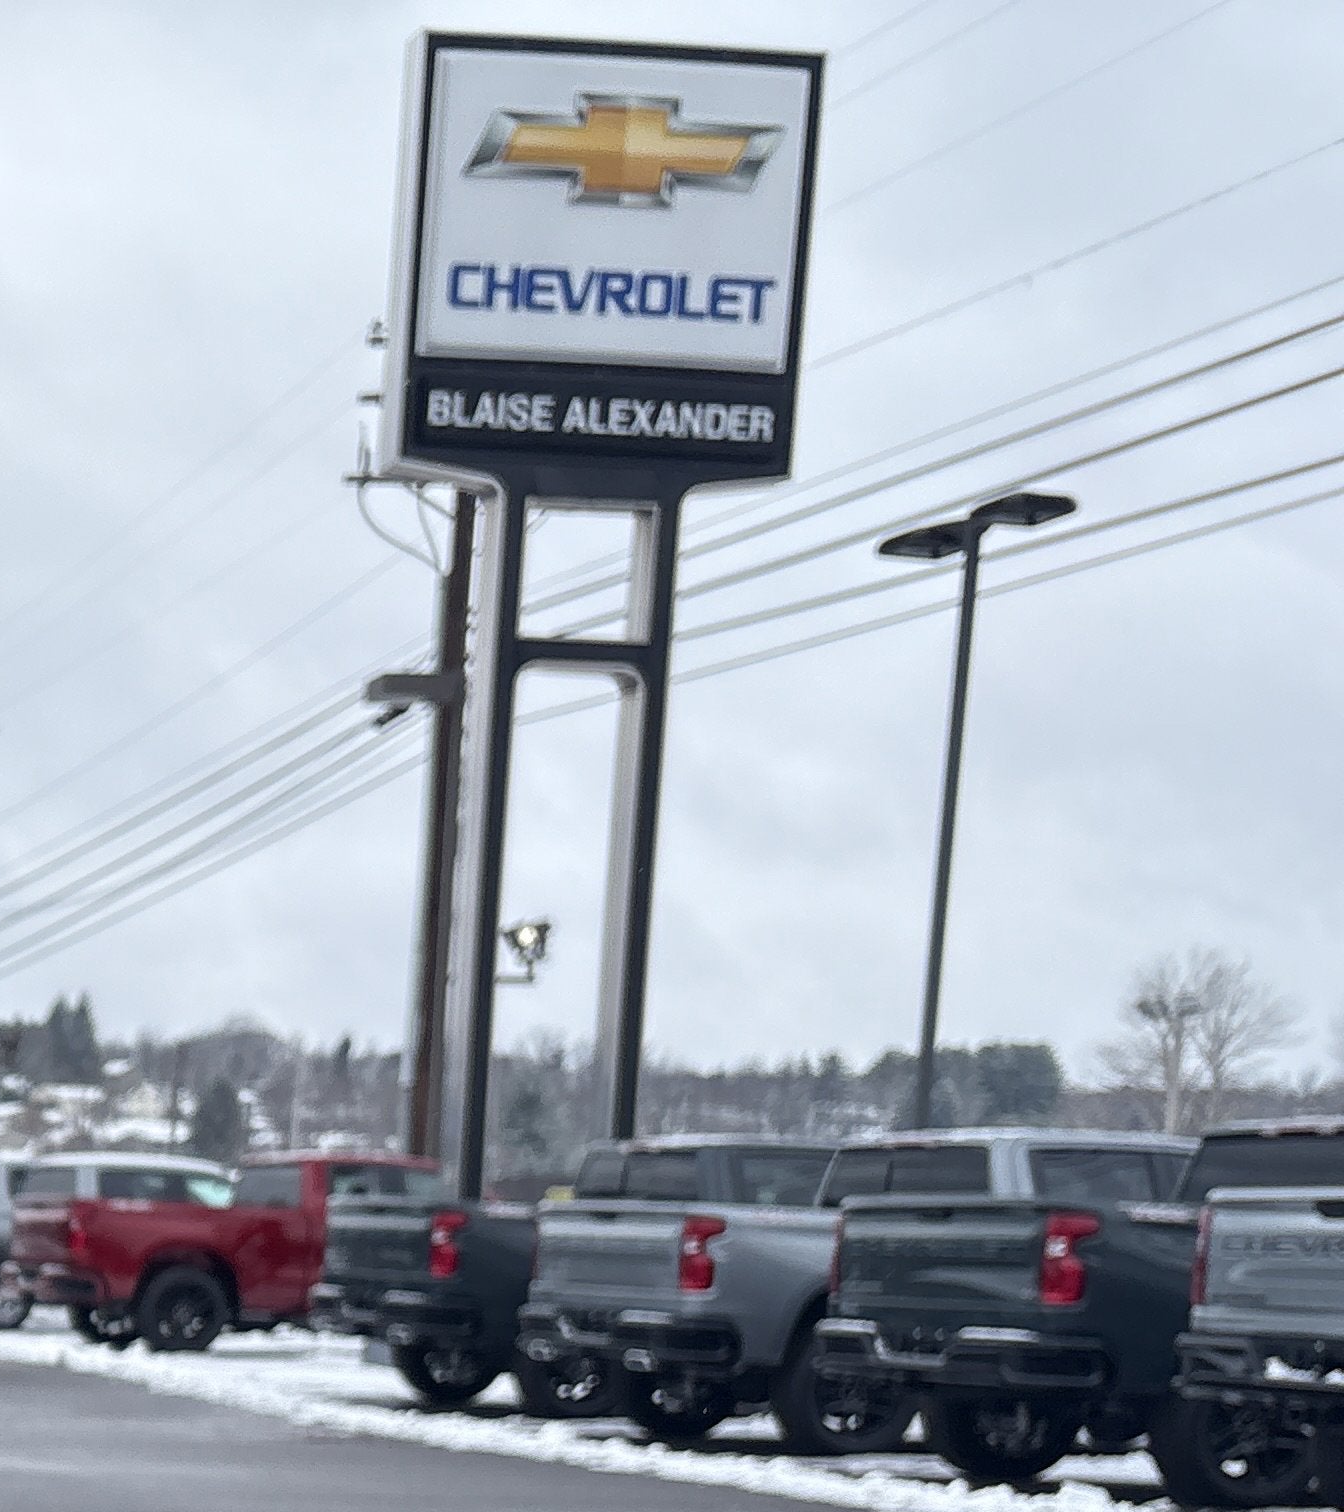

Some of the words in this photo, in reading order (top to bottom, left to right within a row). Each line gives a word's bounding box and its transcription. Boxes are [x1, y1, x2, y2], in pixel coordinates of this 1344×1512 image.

[447, 262, 777, 324] CHEVROLET
[426, 388, 556, 433] BLAISE
[561, 395, 776, 443] ALEXANDER
